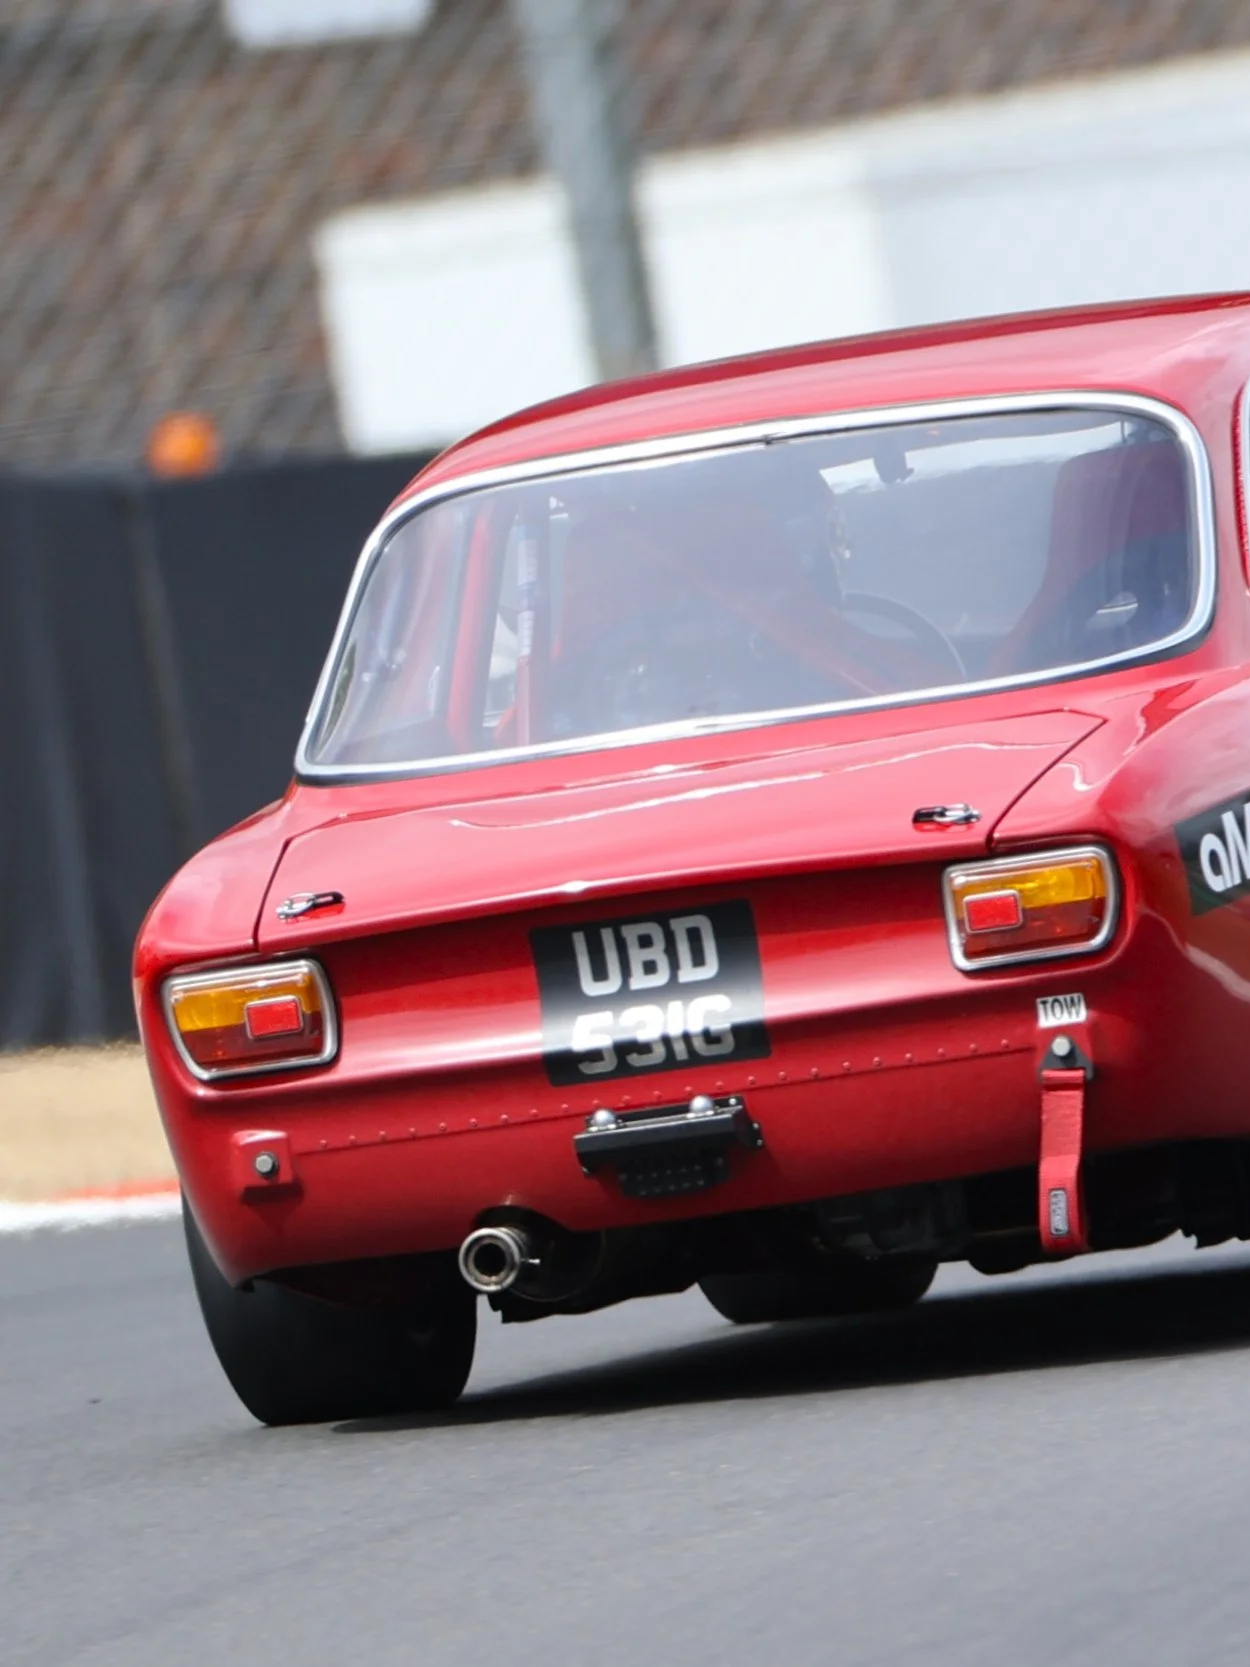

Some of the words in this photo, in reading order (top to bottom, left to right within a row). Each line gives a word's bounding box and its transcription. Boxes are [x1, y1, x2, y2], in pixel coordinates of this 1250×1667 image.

[571, 914, 720, 997] UBD
[571, 994, 735, 1075] 531G
[1039, 994, 1082, 1022] TOW
